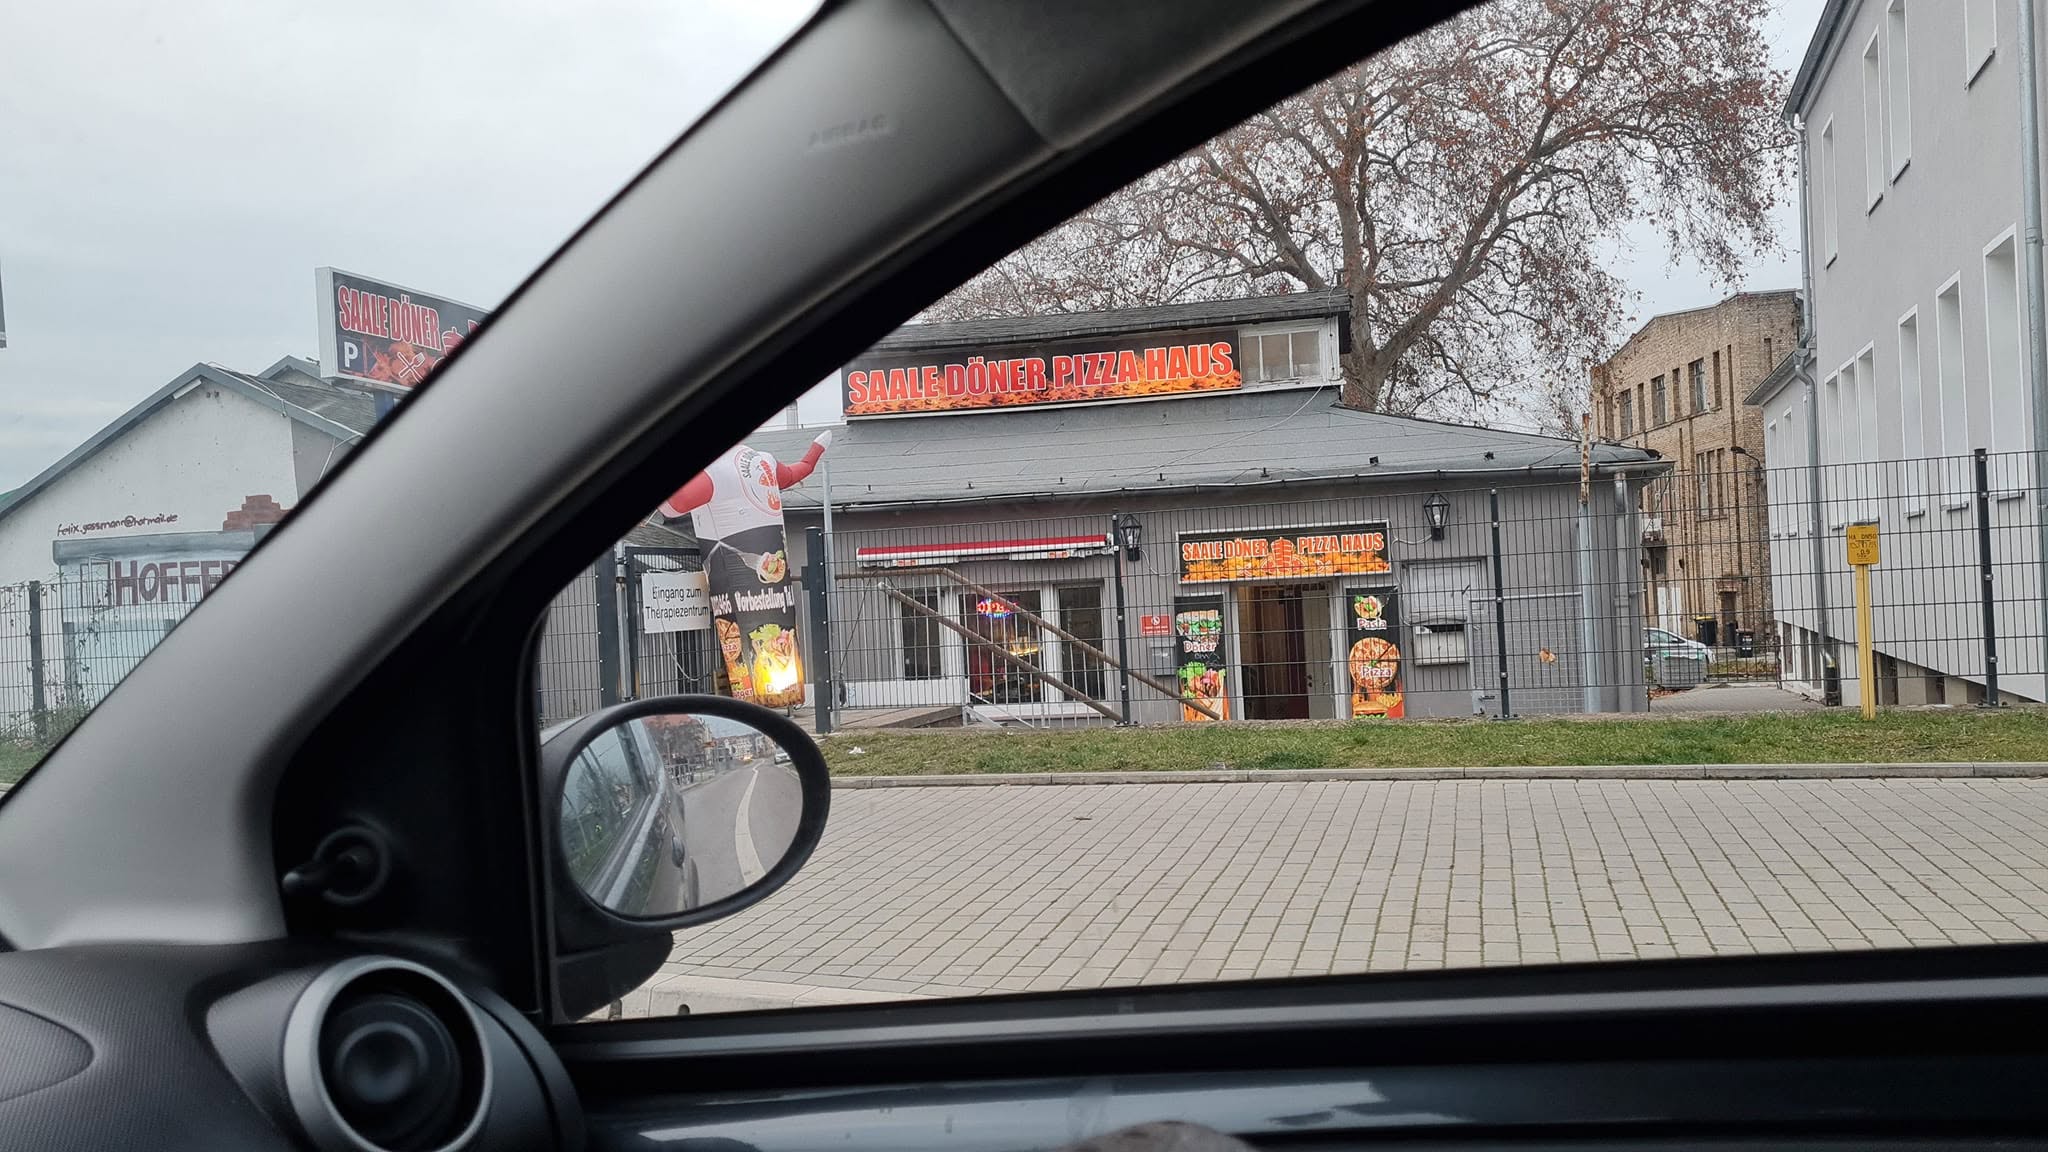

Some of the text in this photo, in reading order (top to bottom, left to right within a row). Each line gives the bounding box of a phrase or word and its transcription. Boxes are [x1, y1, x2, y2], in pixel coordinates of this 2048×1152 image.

[339, 285, 441, 351] SAALE DÖNER
[344, 341, 358, 367] P
[848, 342, 1233, 404] SAALE DÖNER PIZZA HAUS
[1182, 532, 1384, 561] SAALE DÖNER PIZZA HAUS
[652, 586, 702, 602] Eingang zum
[734, 588, 787, 614] Vorbestellung
[645, 605, 709, 621] Therapiezentrum
[1356, 618, 1388, 630] Pasta
[1360, 666, 1393, 678] Pizza
